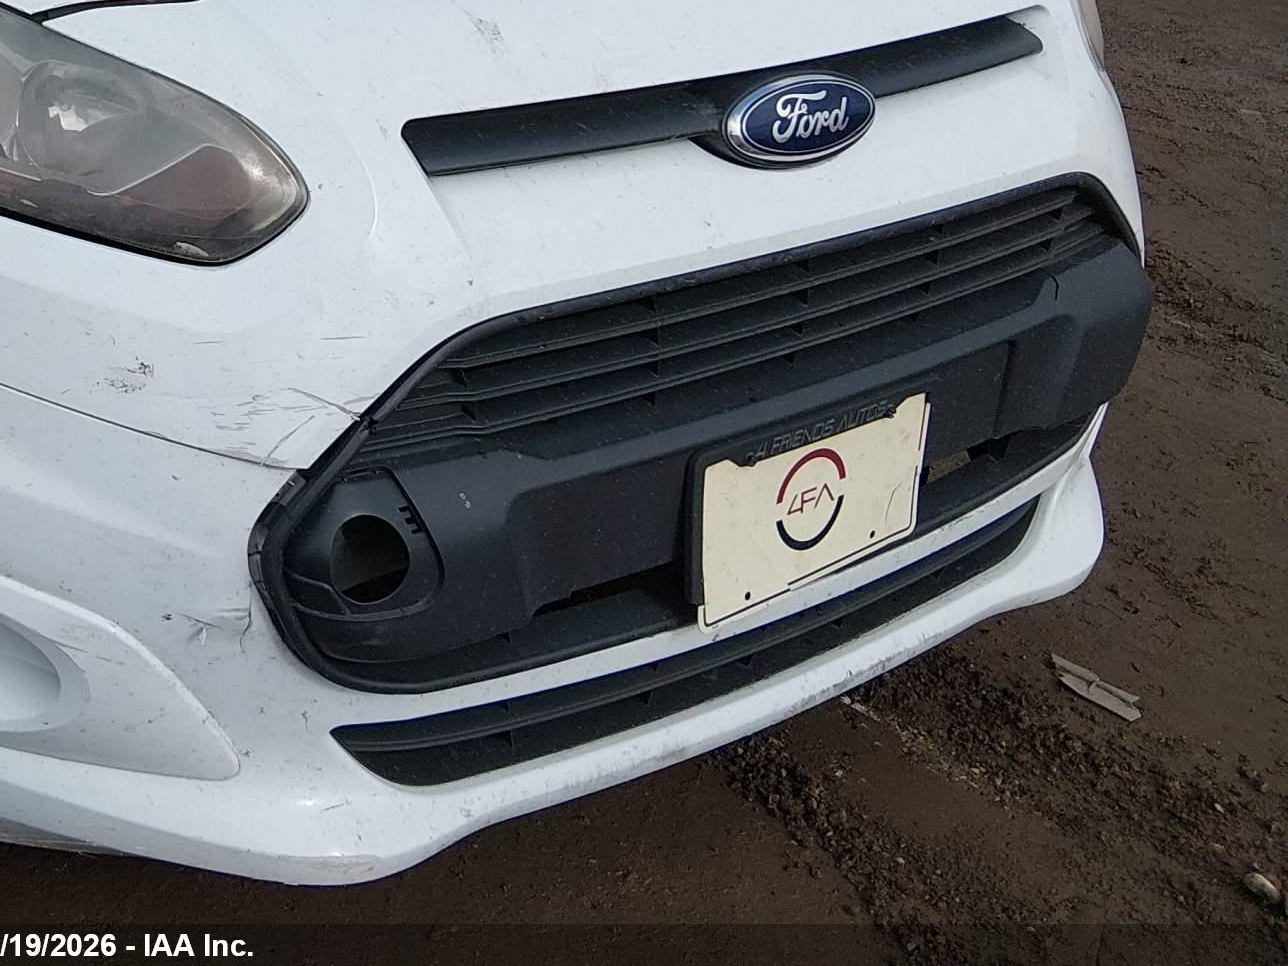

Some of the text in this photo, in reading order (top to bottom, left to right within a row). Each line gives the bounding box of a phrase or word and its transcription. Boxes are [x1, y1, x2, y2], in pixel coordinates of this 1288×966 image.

[772, 90, 849, 143] Ford
[770, 419, 835, 455] FRIENDS
[836, 401, 888, 432] AUTOS
